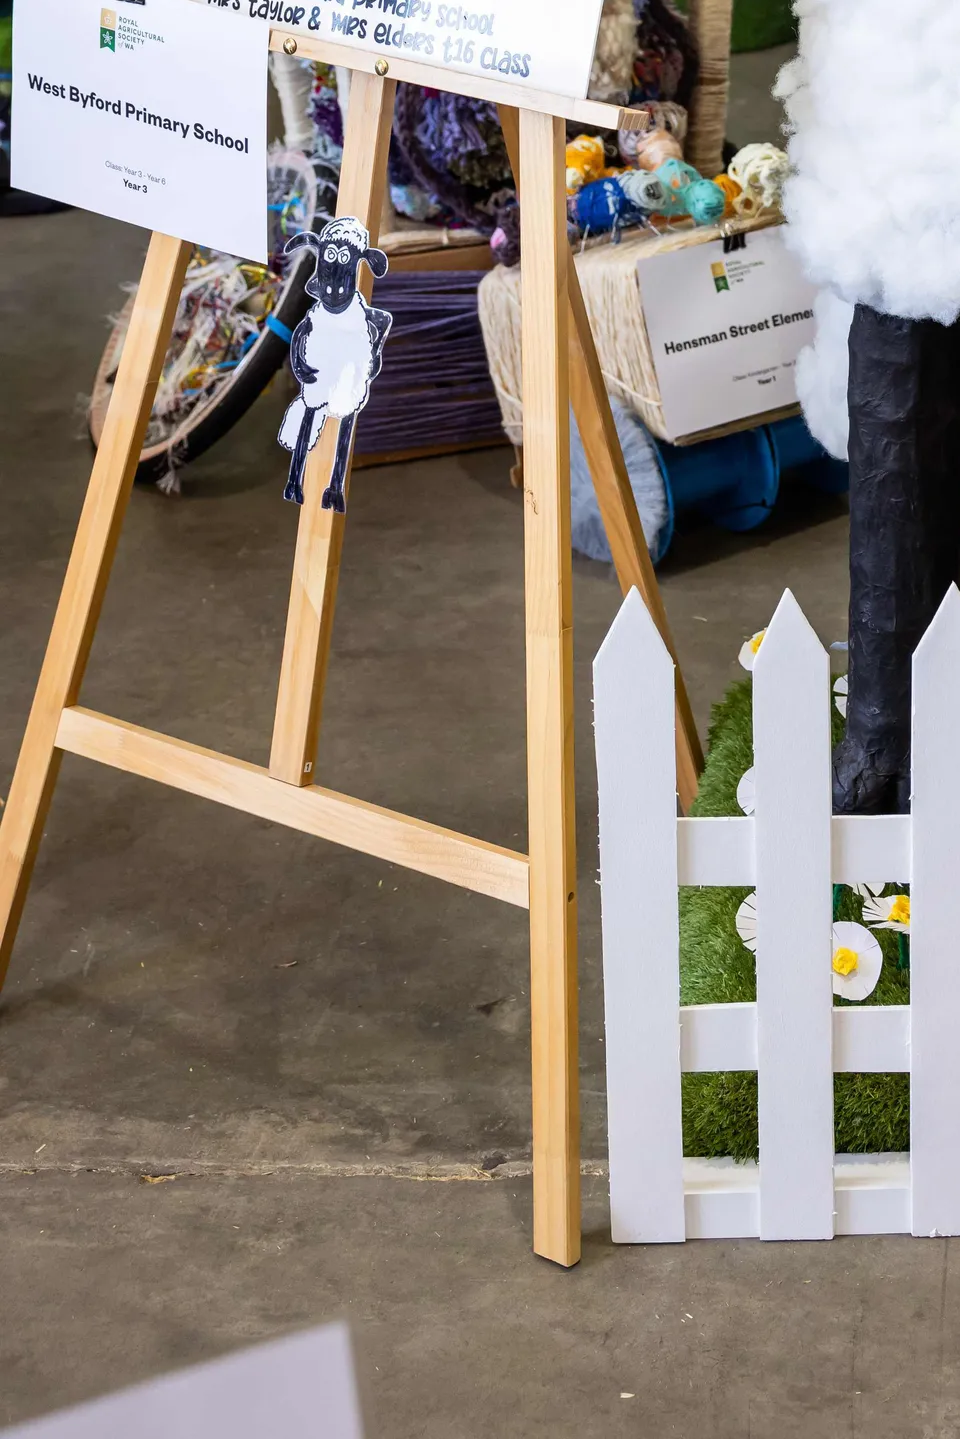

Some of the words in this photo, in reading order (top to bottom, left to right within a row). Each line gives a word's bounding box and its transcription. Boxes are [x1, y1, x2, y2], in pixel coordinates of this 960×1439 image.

[118, 16, 139, 27] ROYAL
[307, 6, 322, 31] &
[117, 25, 165, 43] AGRICULTURAL
[117, 33, 145, 45] SOCIETY
[124, 42, 134, 50] WA
[27, 72, 66, 99] West
[69, 85, 122, 116] Byford
[125, 102, 190, 139] Primary
[193, 122, 249, 153] School
[124, 166, 137, 176] Year
[138, 170, 143, 178] 3
[147, 172, 161, 183] Year
[161, 177, 166, 185] 6
[123, 178, 141, 191] Year
[142, 185, 148, 193] 3
[664, 330, 728, 355] Hensman
[729, 318, 770, 338] Street
